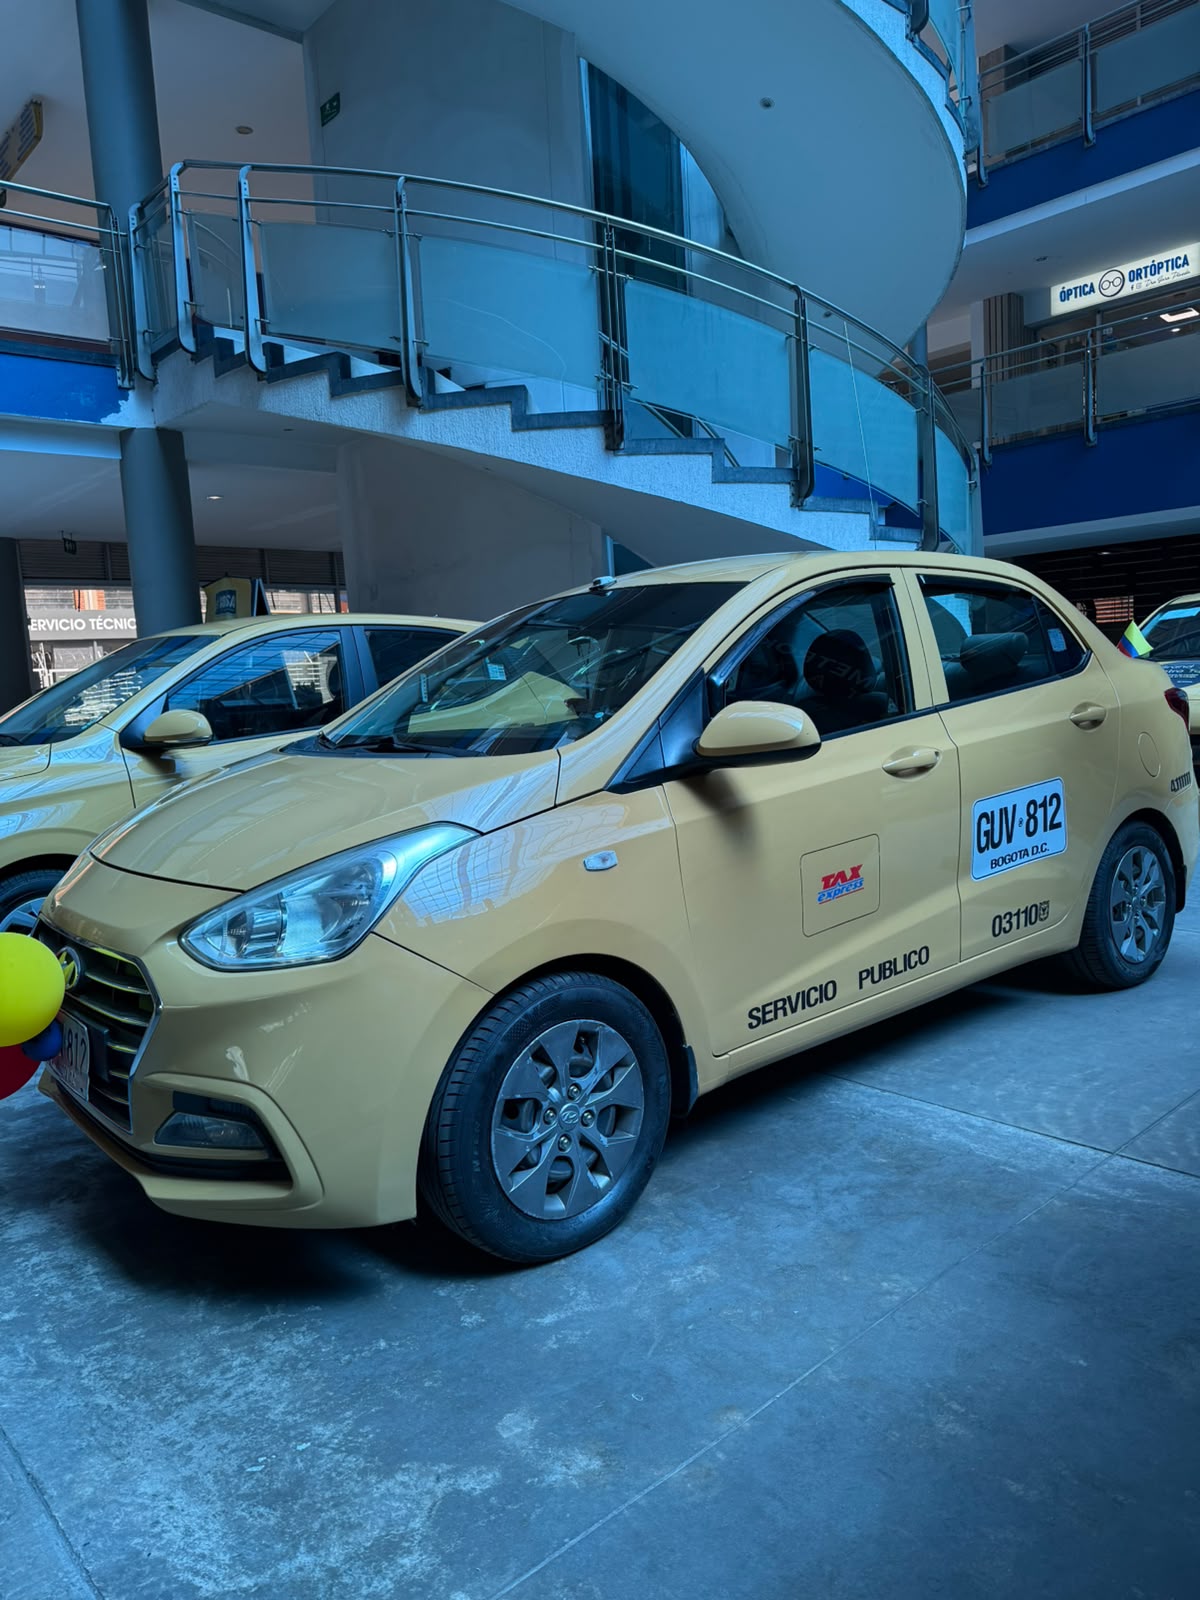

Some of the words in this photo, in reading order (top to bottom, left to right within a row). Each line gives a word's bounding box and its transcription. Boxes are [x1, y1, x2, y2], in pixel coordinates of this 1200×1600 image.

[1059, 282, 1096, 303] ÓPTICA
[1128, 254, 1190, 283] ORTÓPTICA
[28, 618, 86, 632] ERVICIO
[88, 615, 137, 631] TÉCNIC
[976, 803, 1017, 854] GUV
[1025, 792, 1062, 838] 812
[990, 848, 1029, 870] BOGOTA
[1031, 842, 1050, 856] D.C.
[817, 878, 865, 902] express
[821, 864, 863, 890] TAX
[992, 903, 1038, 938] 03110
[747, 979, 837, 1030] SERVICIO
[858, 945, 930, 990] PUBLICO
